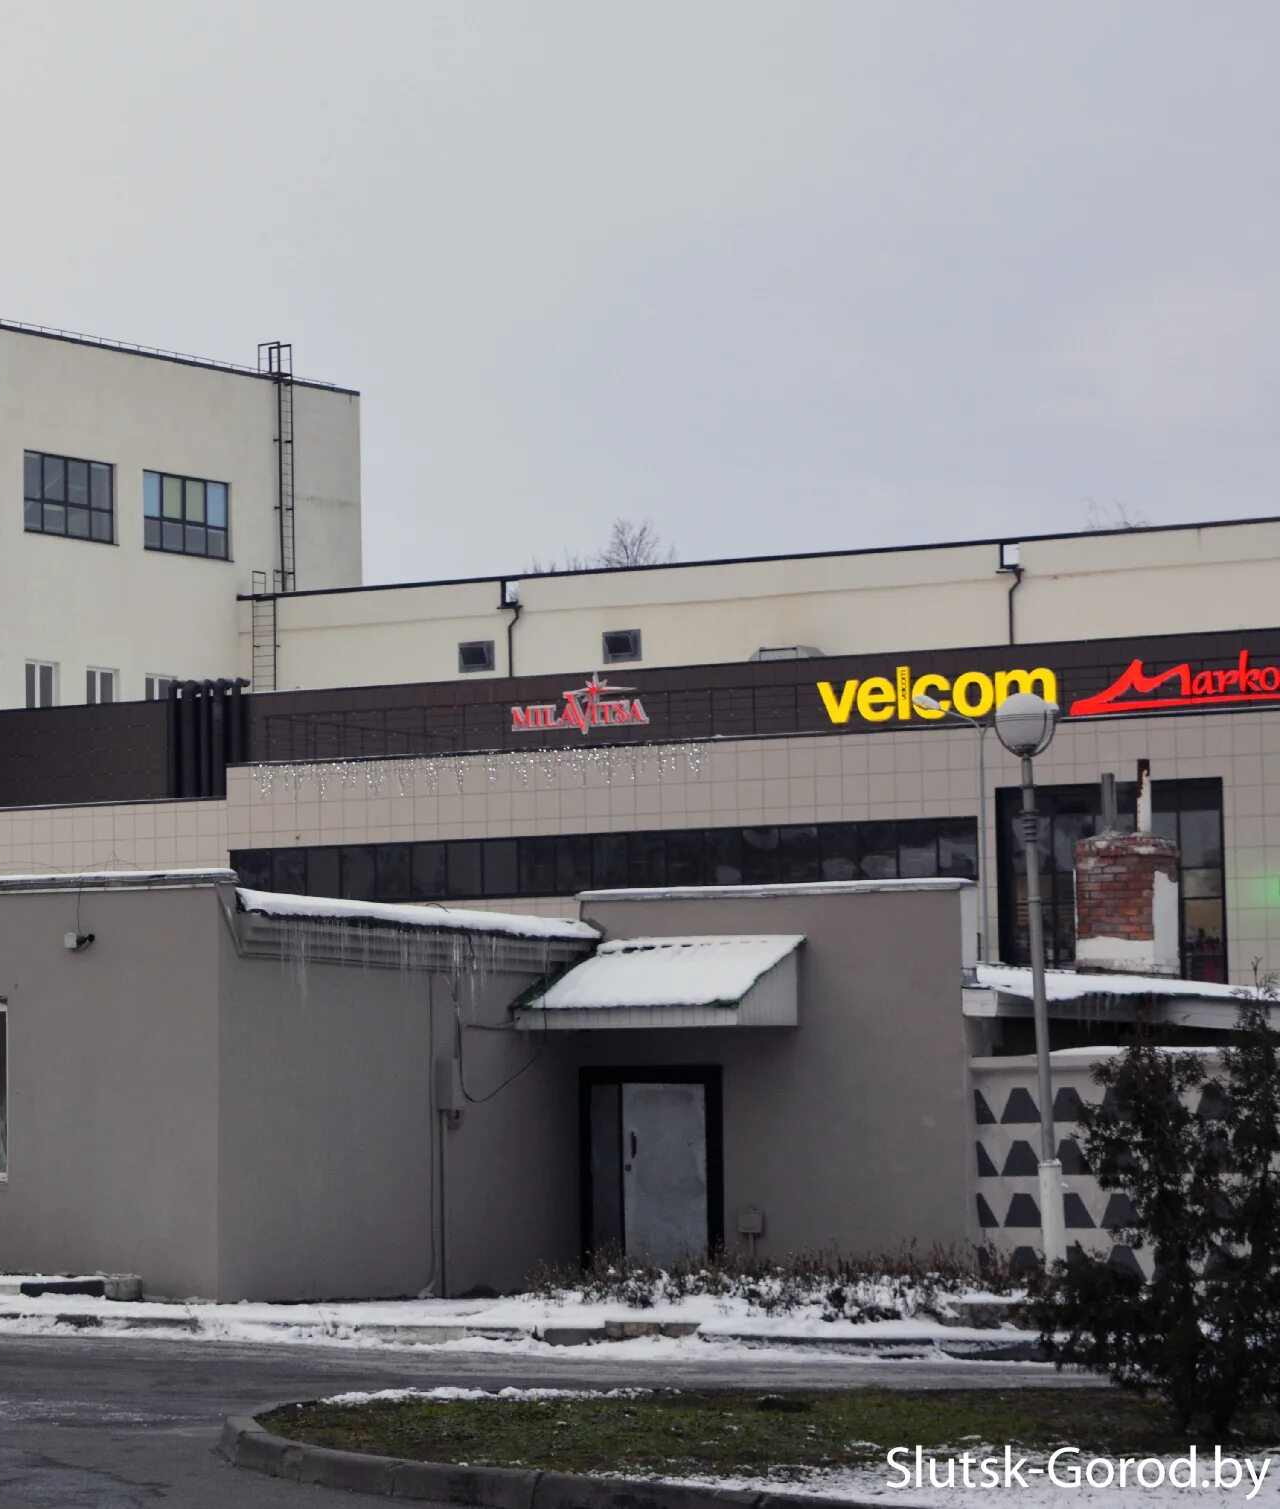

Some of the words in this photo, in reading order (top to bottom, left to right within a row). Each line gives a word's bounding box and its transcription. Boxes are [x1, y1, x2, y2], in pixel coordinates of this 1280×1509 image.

[817, 666, 1057, 723] velcom
[1070, 649, 1280, 716] Marko
[511, 690, 650, 735] MILAVITSA
